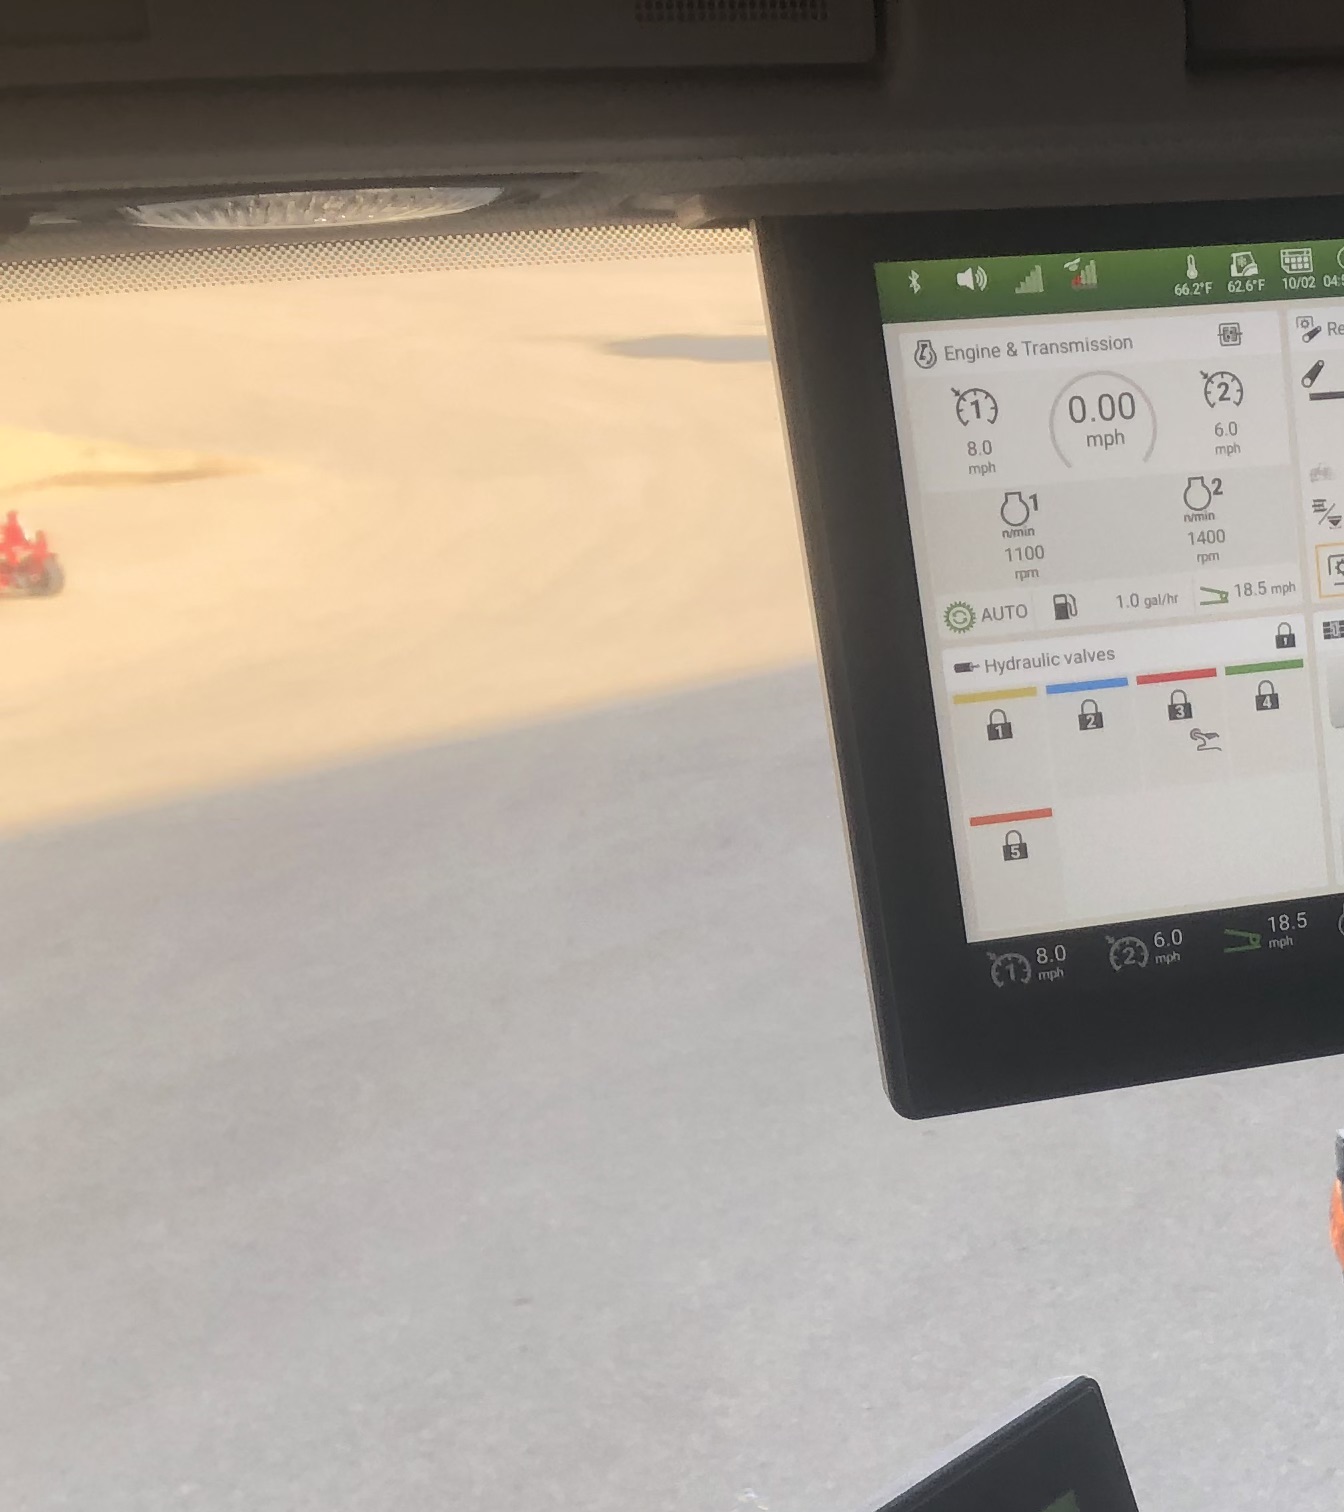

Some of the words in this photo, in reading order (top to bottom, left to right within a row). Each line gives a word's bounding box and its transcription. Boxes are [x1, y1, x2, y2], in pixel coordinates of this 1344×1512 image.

[1282, 277, 1316, 289] 10/02
[944, 345, 1000, 364] Engine
[1006, 342, 1018, 356] &
[1022, 336, 1133, 356] Transmission
[1068, 392, 1136, 423] 0.00
[1215, 421, 1238, 437] 6.0
[967, 440, 992, 457] 8.0
[1086, 430, 1125, 450] mph
[1215, 442, 1240, 455] mph
[969, 462, 996, 475] mph
[1184, 510, 1215, 523] n/min
[1188, 529, 1226, 546] 1400
[1004, 545, 1045, 562] 1100
[1197, 551, 1219, 563] rpm
[1015, 567, 1039, 580] rpm
[1234, 581, 1266, 597] 18.5
[1271, 581, 1296, 596] mph
[1116, 593, 1139, 609] 1.0
[1145, 592, 1178, 608] gal/hr
[981, 605, 1028, 622] AUTO
[985, 653, 1060, 673] Hydraulic
[1064, 648, 1115, 665] valves
[1268, 912, 1308, 933] 18.5
[1154, 929, 1183, 948] 6.0
[1269, 936, 1293, 949] mph
[1036, 945, 1067, 964] 8.0
[1155, 951, 1180, 966] mph
[1038, 967, 1064, 981] mph
